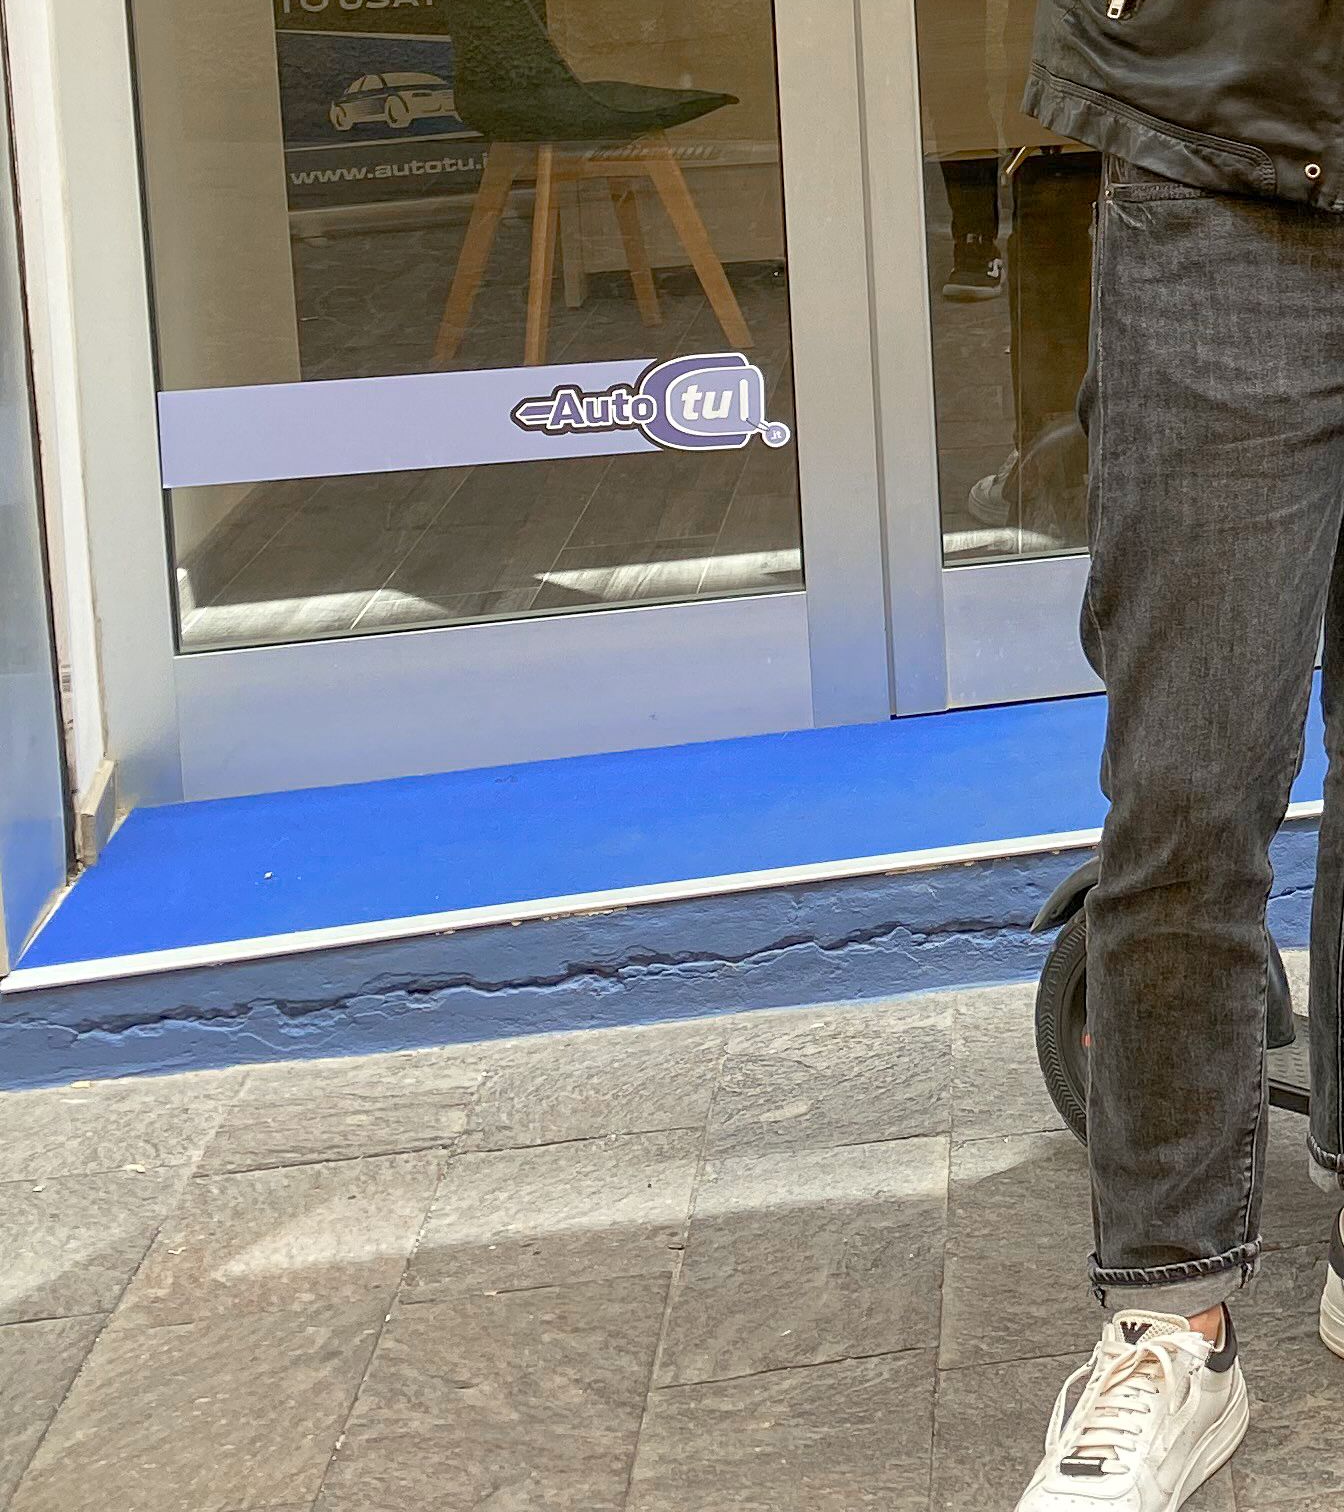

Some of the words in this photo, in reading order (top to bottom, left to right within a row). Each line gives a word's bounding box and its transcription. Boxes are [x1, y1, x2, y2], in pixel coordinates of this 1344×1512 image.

[291, 153, 487, 184] www.autotu.i
[550, 392, 654, 426] Auto
[682, 385, 732, 420] tu
